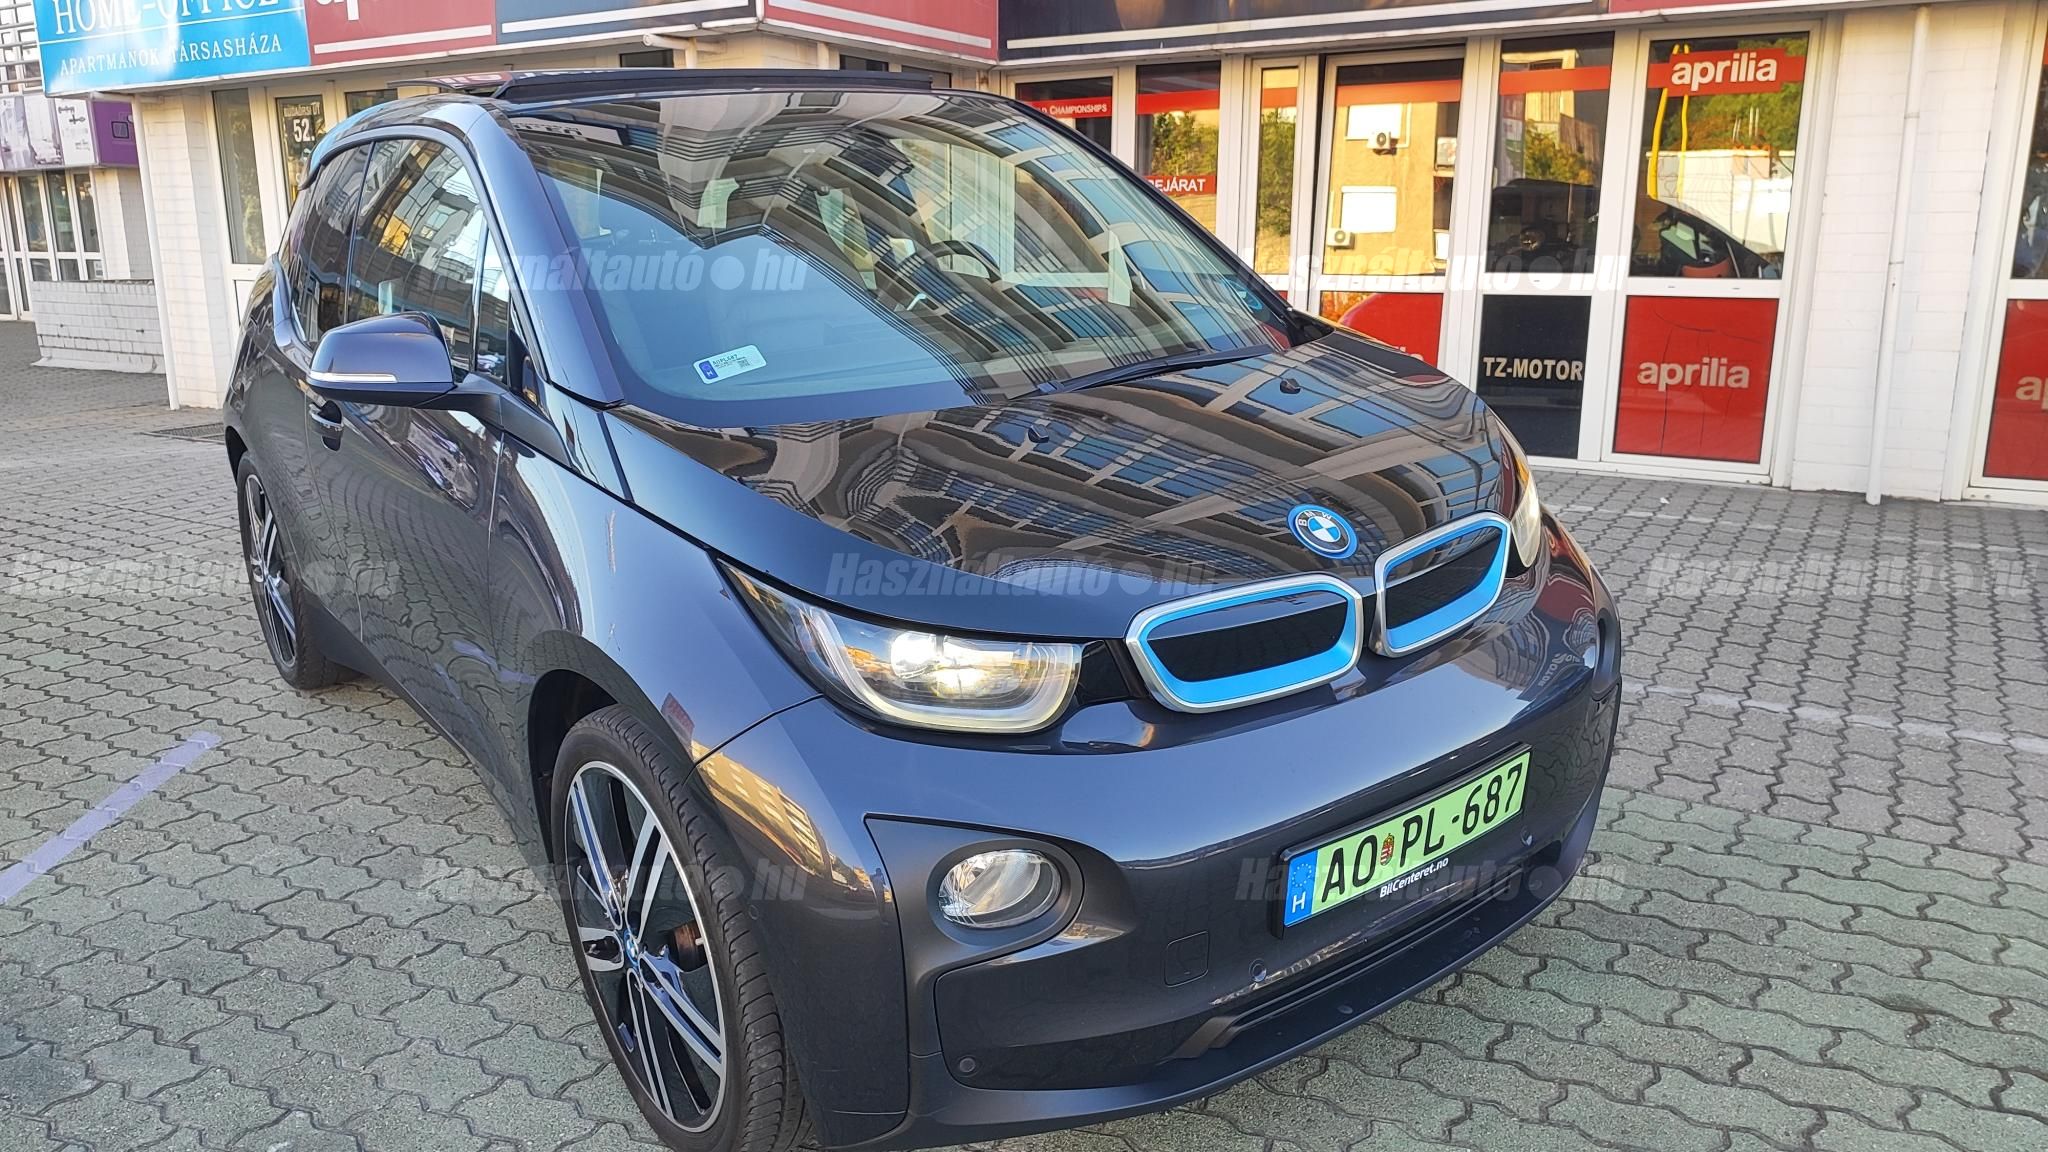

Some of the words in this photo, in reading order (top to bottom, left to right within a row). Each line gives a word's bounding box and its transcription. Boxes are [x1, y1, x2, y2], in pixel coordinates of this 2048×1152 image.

[59, 47, 160, 77] APARTMANOK
[170, 32, 283, 63] TÁRSASHÁZA
[1671, 52, 1777, 91] aprilia
[293, 118, 315, 142] 52.
[1483, 357, 1583, 380] TZ-MOTOR
[1637, 357, 1750, 392] aprilia
[1298, 511, 1332, 526] BMW
[1321, 834, 1377, 902] AO
[1379, 857, 1449, 898] BilCenteret.no
[1291, 891, 1306, 913] H
